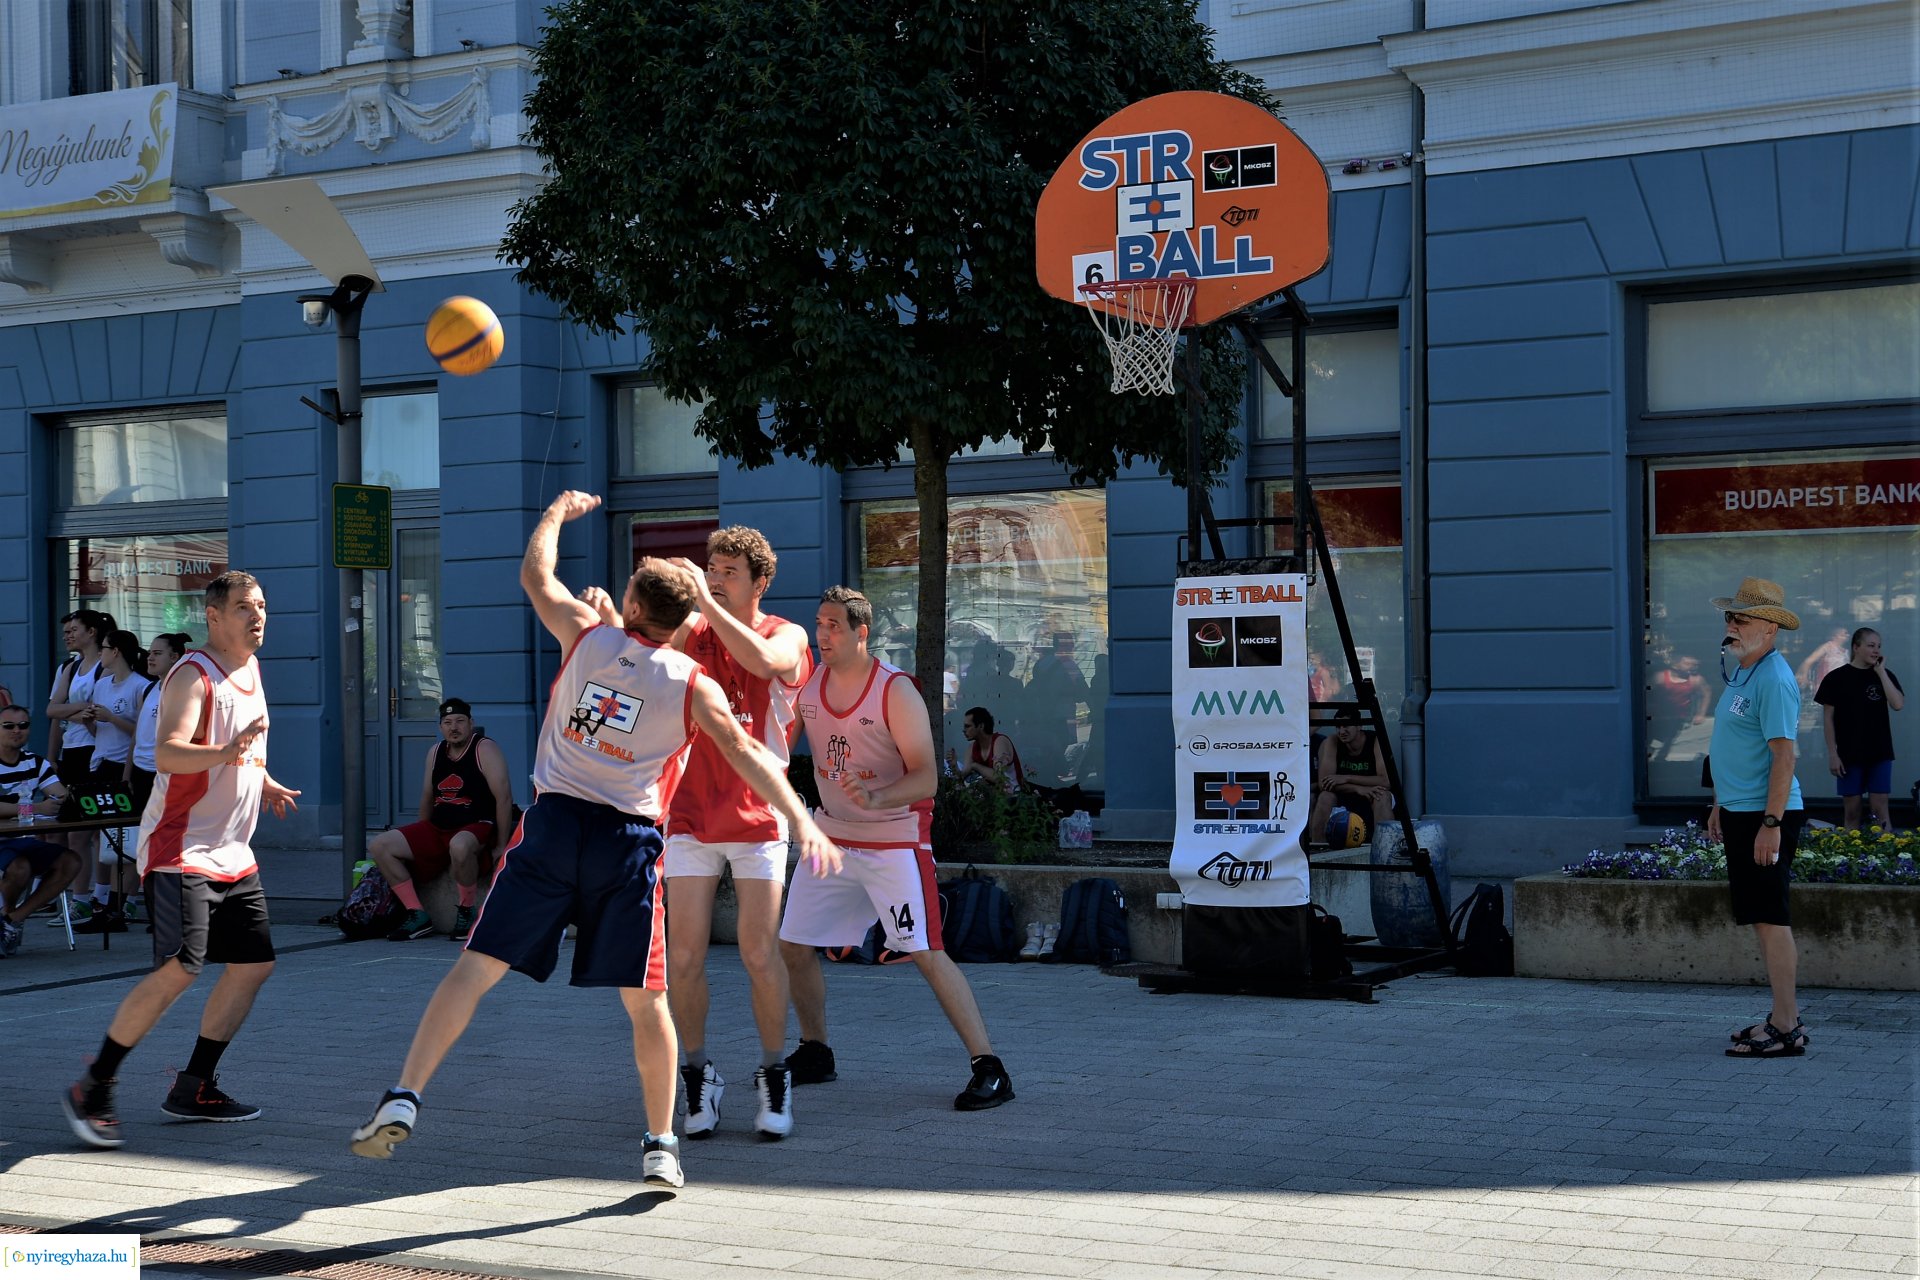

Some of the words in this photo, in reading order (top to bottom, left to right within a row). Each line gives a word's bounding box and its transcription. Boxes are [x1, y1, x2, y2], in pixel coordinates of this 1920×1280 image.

[1243, 161, 1272, 171] MKOSZ
[1116, 225, 1274, 281] BALL
[1085, 263, 1104, 286] 6
[1725, 485, 1848, 510] BUDAPEST
[1855, 482, 1920, 505] BANK
[103, 560, 171, 578] BUDAPEST
[174, 559, 212, 576] BANK
[1240, 636, 1278, 645] MKOSZ
[1191, 689, 1285, 716] MVM
[1192, 741, 1207, 750] GB
[1212, 741, 1294, 750] GROSBASKET
[80, 796, 98, 815] 9
[114, 793, 132, 813] 9
[889, 902, 915, 933] 14
